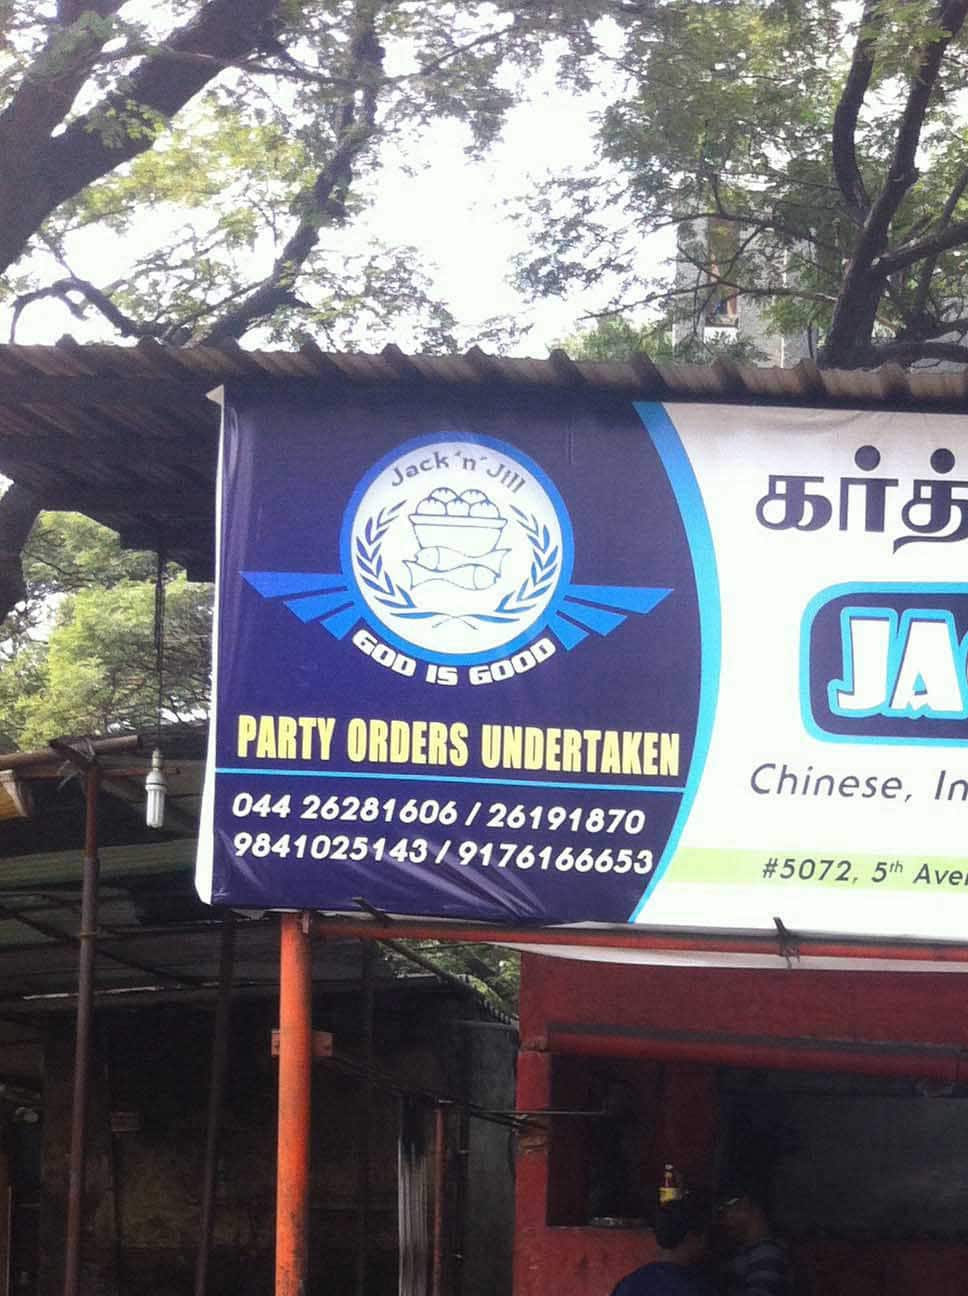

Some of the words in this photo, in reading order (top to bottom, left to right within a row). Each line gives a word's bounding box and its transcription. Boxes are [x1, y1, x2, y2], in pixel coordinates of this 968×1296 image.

[391, 451, 449, 487] Jack
[486, 463, 526, 493] Jill
[352, 629, 417, 677] GOD
[425, 664, 459, 686] IS
[469, 637, 557, 686] GOOD
[237, 714, 336, 761] PARTY
[347, 717, 469, 767] ORDERS
[481, 724, 680, 776] UNDERTAKEN
[751, 763, 912, 802] Chinese,
[232, 792, 291, 818] 044
[300, 794, 458, 825] 26281606
[486, 802, 646, 835] 26191870
[233, 831, 428, 864] 9841025143
[458, 840, 654, 875] 9176166653
[762, 858, 858, 885] #5072,
